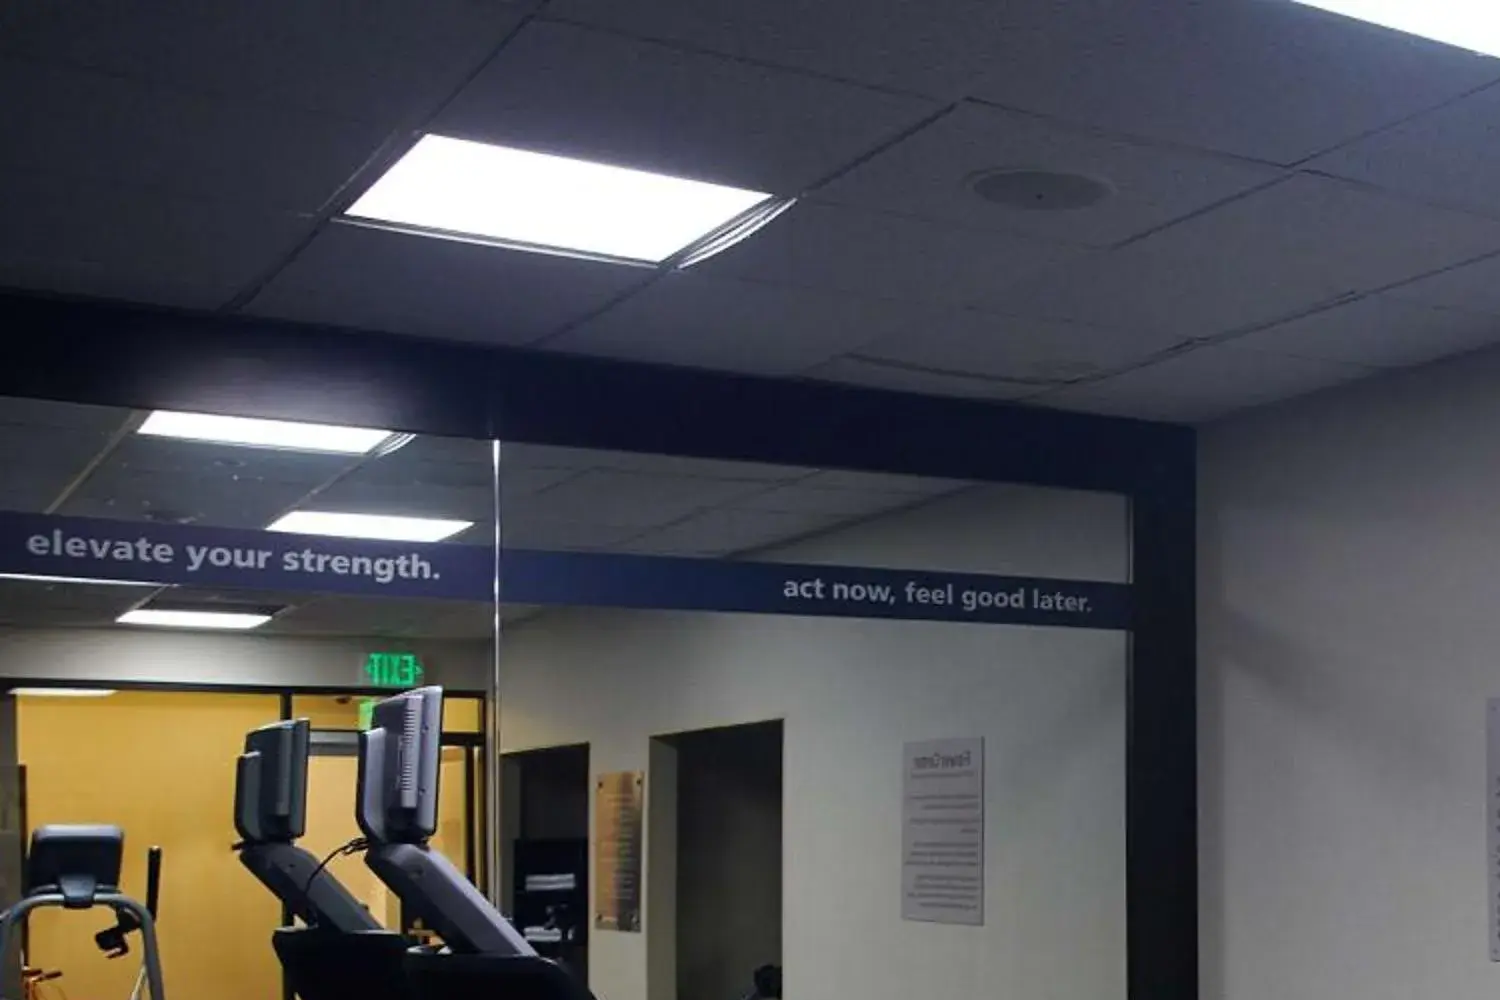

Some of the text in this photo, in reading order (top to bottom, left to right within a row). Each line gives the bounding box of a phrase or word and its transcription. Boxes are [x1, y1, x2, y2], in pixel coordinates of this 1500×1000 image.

[26, 527, 441, 584] elevate your strength.
[783, 578, 1093, 614] act now, feel good later.
